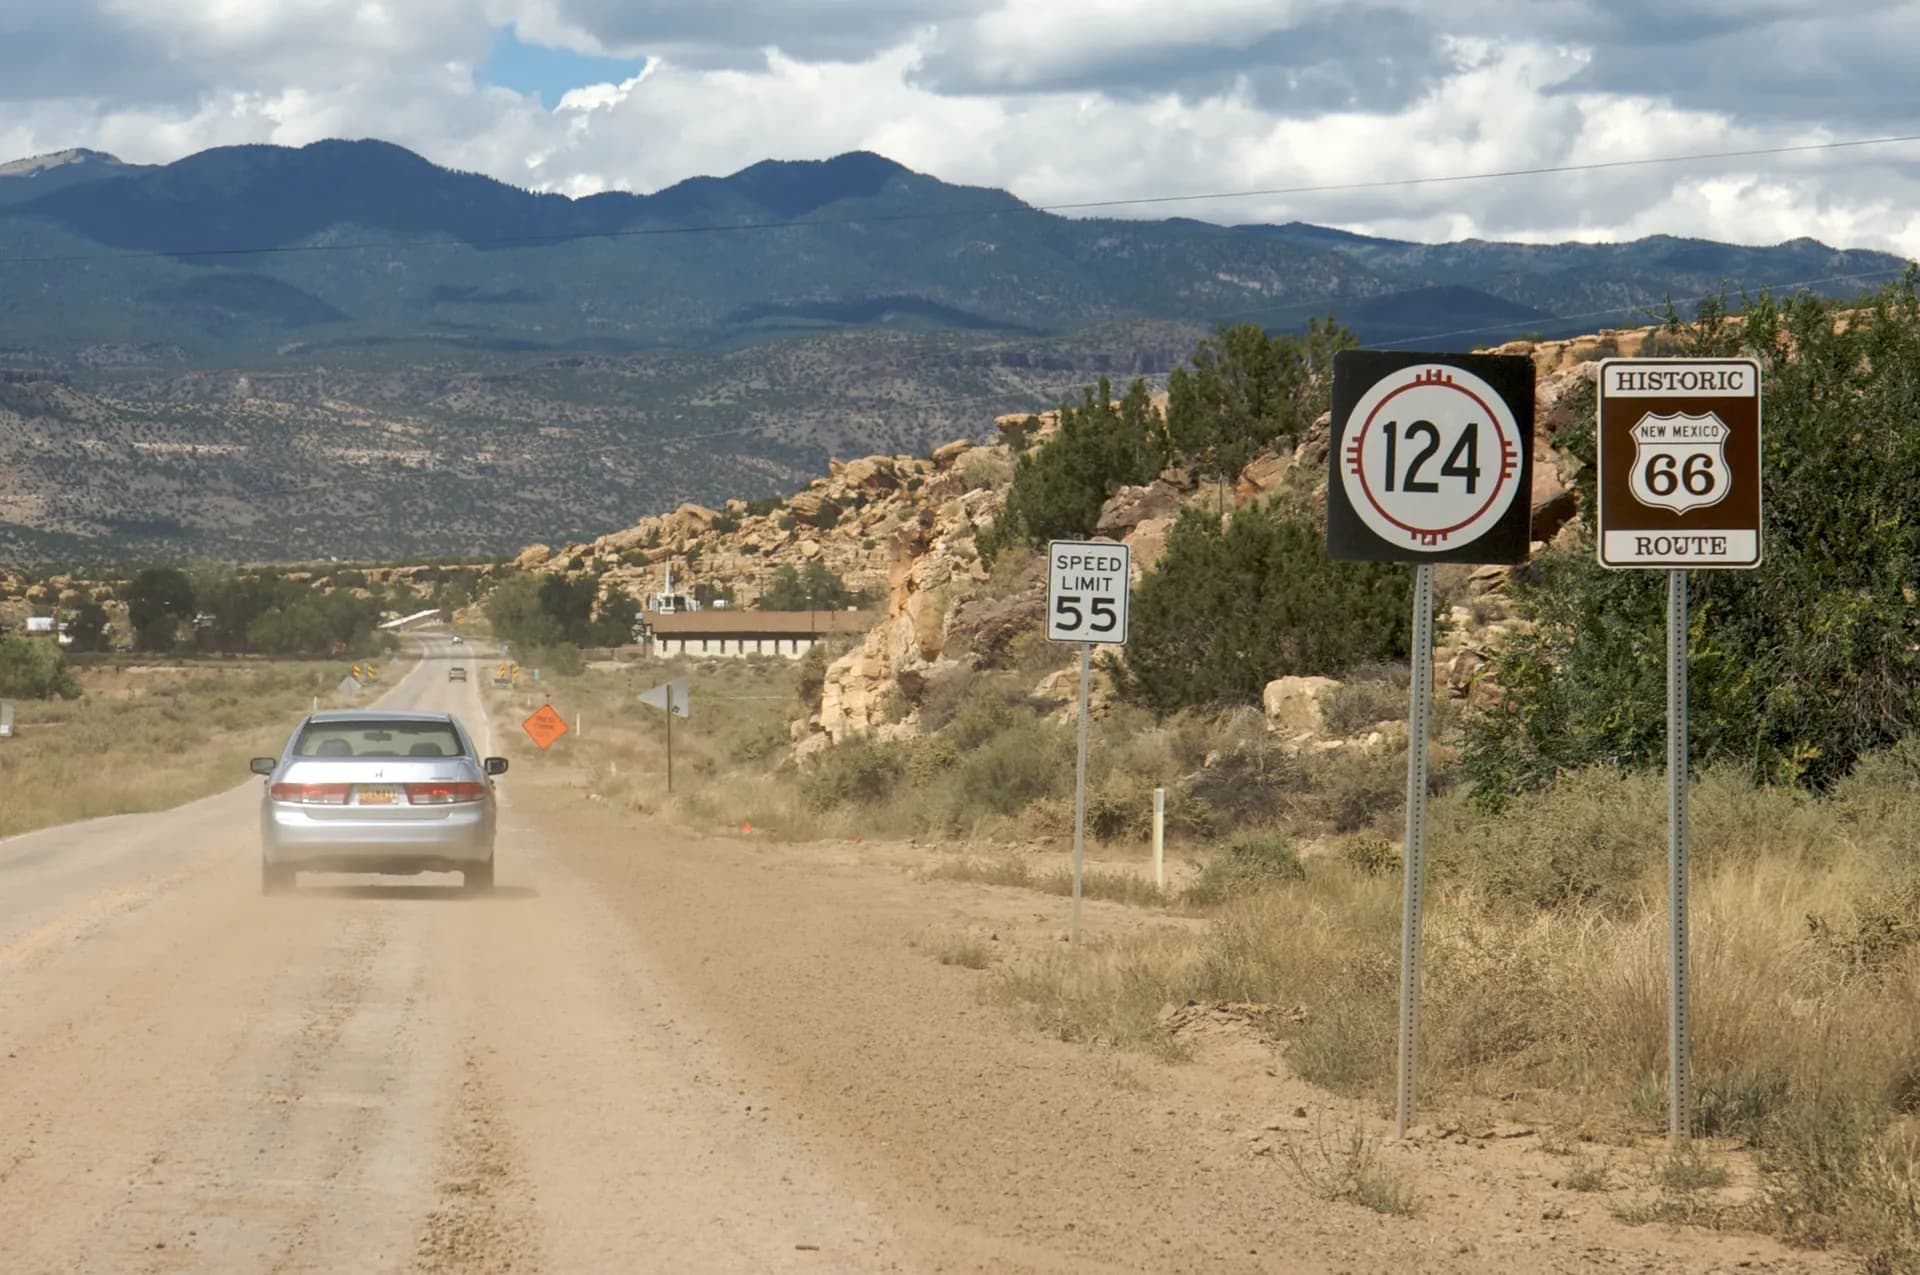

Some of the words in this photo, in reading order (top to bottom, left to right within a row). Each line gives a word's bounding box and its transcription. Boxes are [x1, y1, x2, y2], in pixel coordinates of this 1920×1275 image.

[1616, 371, 1744, 391] HISTORIC
[1641, 425, 1666, 438] NEW
[1672, 425, 1719, 438] MEXICO
[1383, 419, 1481, 495] 124
[1644, 453, 1716, 497] 66
[1635, 536, 1727, 556] ROUTE
[1056, 555, 1122, 572] SPEED
[1062, 575, 1113, 592] LIMIT
[1055, 595, 1117, 632] 55
